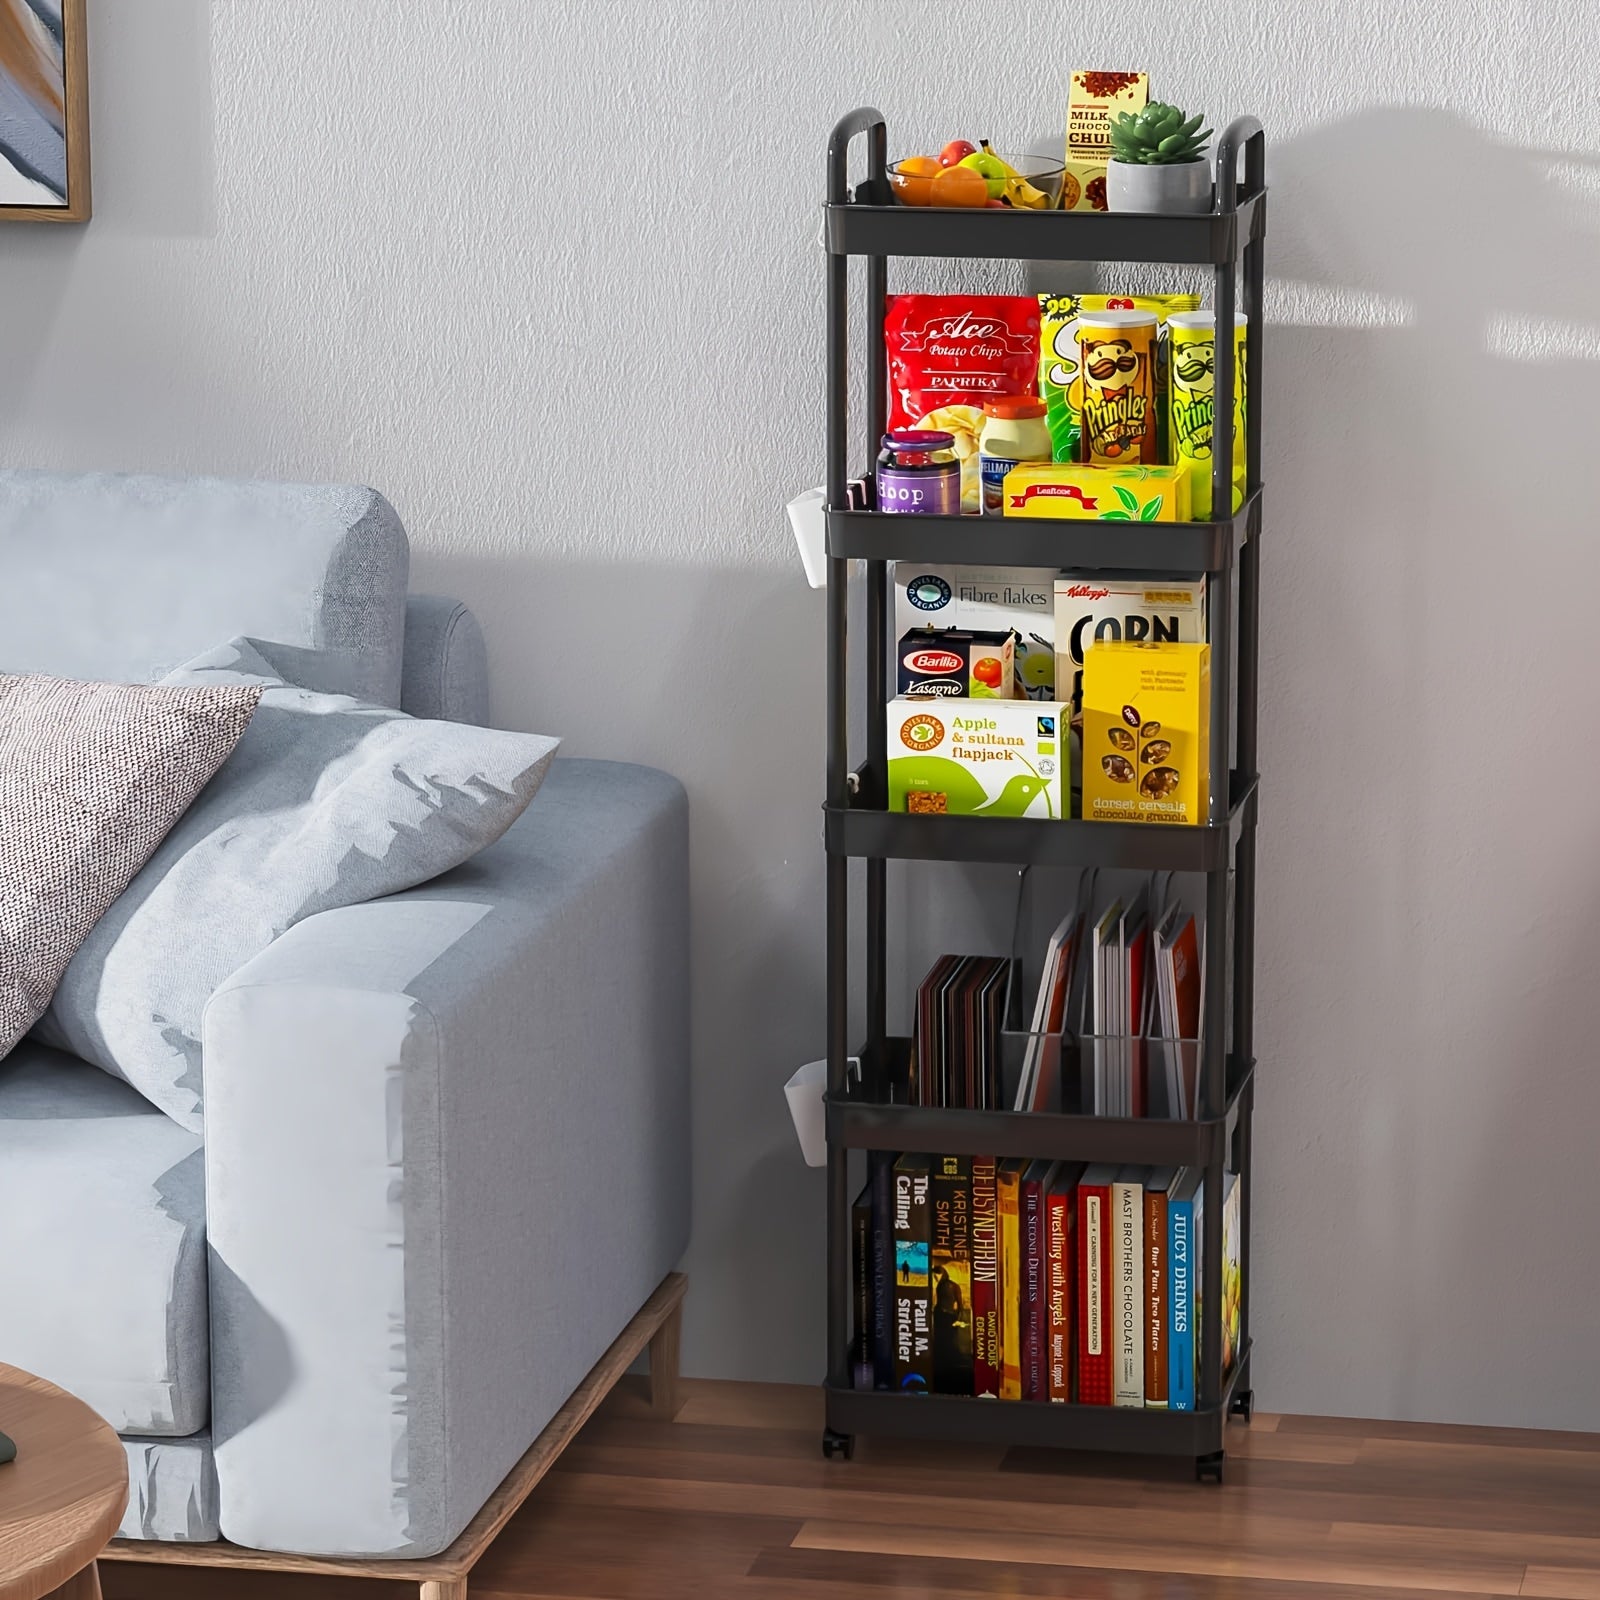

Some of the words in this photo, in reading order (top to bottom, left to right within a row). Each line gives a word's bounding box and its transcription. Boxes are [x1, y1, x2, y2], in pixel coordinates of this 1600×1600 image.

[1070, 122, 1111, 131] CHOCO
[1071, 111, 1108, 121] MILK
[1069, 132, 1111, 144] CHU
[929, 310, 1001, 339] Ace
[929, 344, 967, 356] Potato
[970, 344, 1003, 360] Chips
[931, 376, 998, 388] PAPRIKA
[1083, 388, 1147, 440] Pringles
[1173, 399, 1214, 441] Pring
[911, 595, 949, 609] ORGANIC
[959, 586, 999, 603] Fibre
[1003, 587, 1048, 605] flakes
[1067, 584, 1110, 601] Kellogg's
[917, 655, 958, 668] Barilla
[904, 680, 963, 698] Lasagne
[952, 716, 997, 732] Apple
[905, 733, 943, 750] ORGANIC
[952, 732, 964, 743] &
[968, 733, 1025, 746] sultana
[952, 746, 1014, 763] flapjack
[1092, 808, 1145, 820] chocolate
[1146, 811, 1189, 823] granola
[1093, 797, 1135, 810] dorset
[1138, 801, 1187, 813] cereals
[894, 1175, 911, 1230] Calling
[913, 1175, 929, 1205] The
[1027, 1193, 1038, 1211] THE
[1122, 1189, 1133, 1220] MAST
[936, 1200, 950, 1247] SMITH
[953, 1190, 968, 1260] KRISTINE
[1028, 1214, 1039, 1255] SECOND
[1049, 1205, 1065, 1260] Wrestling
[1174, 1213, 1187, 1263] JUICY
[1123, 1222, 1134, 1282] BROTHERS
[1151, 1246, 1160, 1267] One
[1028, 1257, 1040, 1302] DUCHESS
[1051, 1262, 1065, 1289] with
[1050, 1289, 1067, 1327] Angels
[1151, 1296, 1160, 1317] Two
[1174, 1266, 1187, 1333] DRINKS
[914, 1299, 928, 1333] Paul
[987, 1310, 997, 1338] DAVID
[1123, 1285, 1134, 1355] CHOCOLATE
[898, 1298, 911, 1363] Strickler
[976, 1316, 985, 1360] EDELMAN
[1151, 1318, 1160, 1352] Plates
[915, 1337, 928, 1357] M.
[987, 1338, 998, 1368] LOUIS
[1176, 1402, 1187, 1411] W
